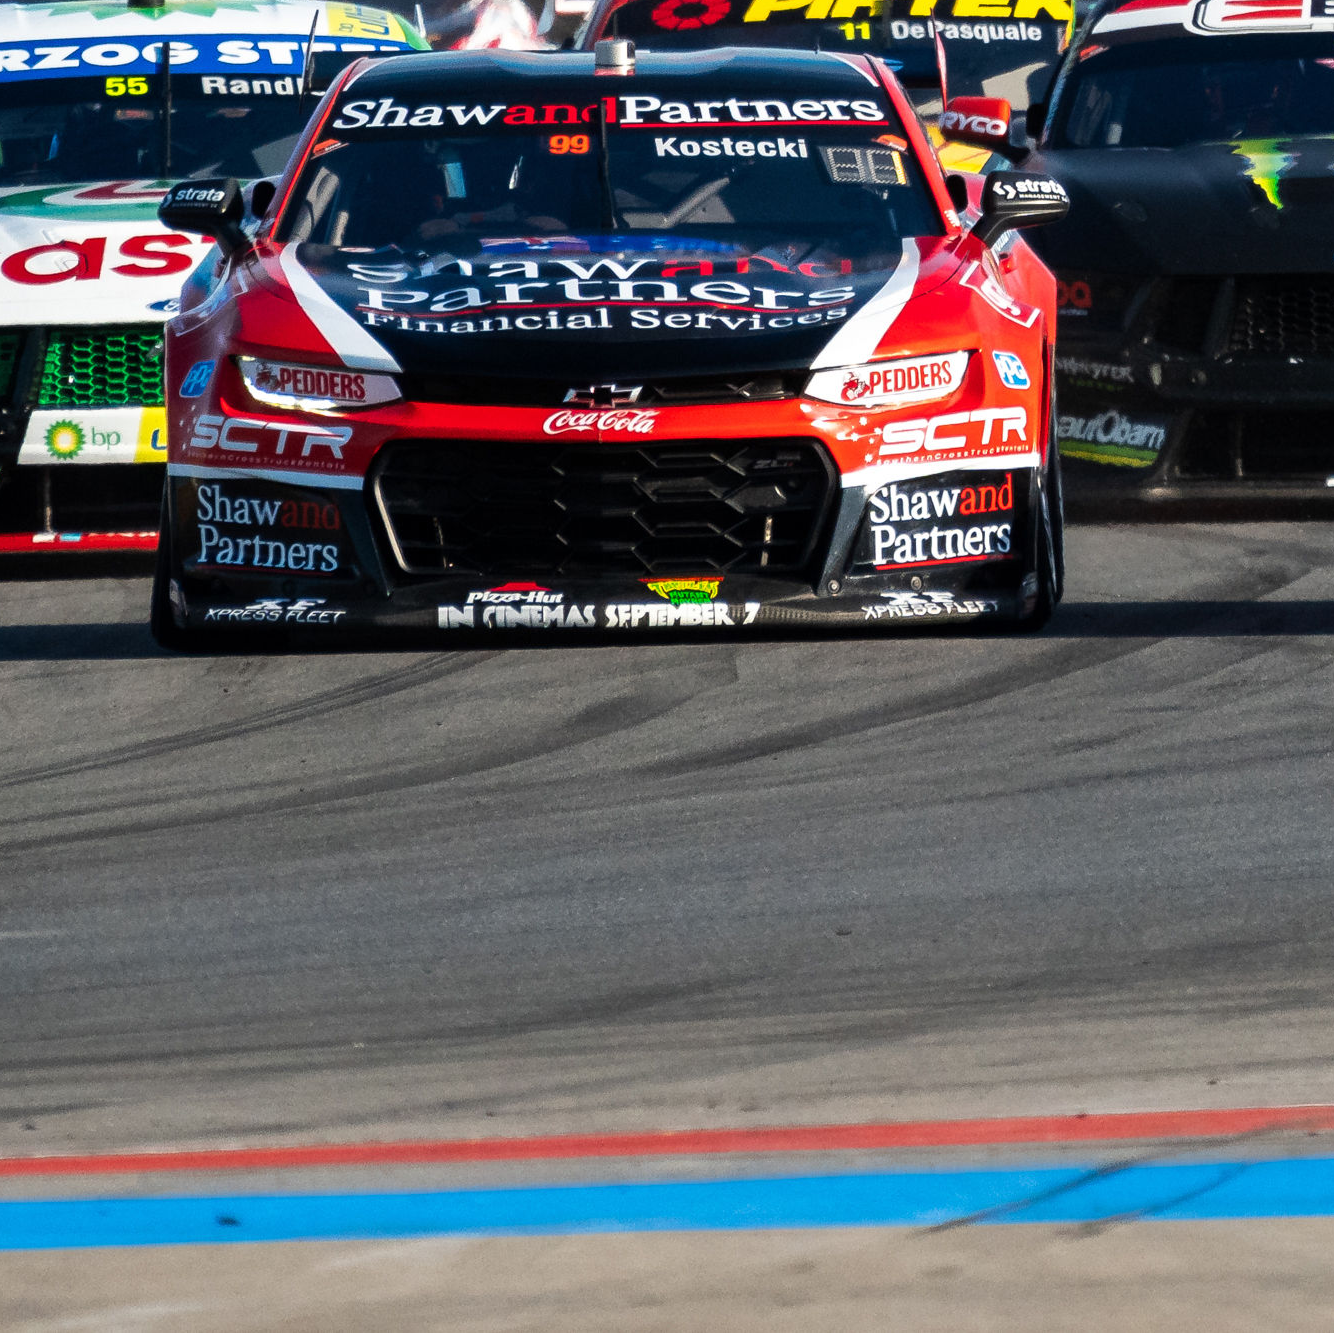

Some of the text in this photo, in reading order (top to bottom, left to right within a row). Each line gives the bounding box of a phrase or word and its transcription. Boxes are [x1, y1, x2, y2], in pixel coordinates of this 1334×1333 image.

[838, 22, 871, 41] 11
[104, 76, 149, 97] 55
[939, 109, 1008, 136] RYCO
[548, 134, 591, 155] 99
[654, 136, 809, 159] Kostecki
[174, 186, 226, 203] strata
[1015, 178, 1067, 194] strata
[365, 277, 857, 312] Partners
[365, 306, 849, 333] Financial Services
[278, 367, 366, 401] PEDDERS
[868, 360, 953, 395] PEDDERS
[91, 420, 122, 451] bp
[542, 409, 657, 436] Coca-Cola
[878, 406, 1028, 457] SCTR
[189, 415, 354, 460] SCTR
[196, 523, 339, 573] Partners
[870, 523, 1012, 566] Partners
[203, 608, 347, 624] XPRESS FLEET
[437, 602, 762, 629] IN CINEMAS SEPTEMBER 7
